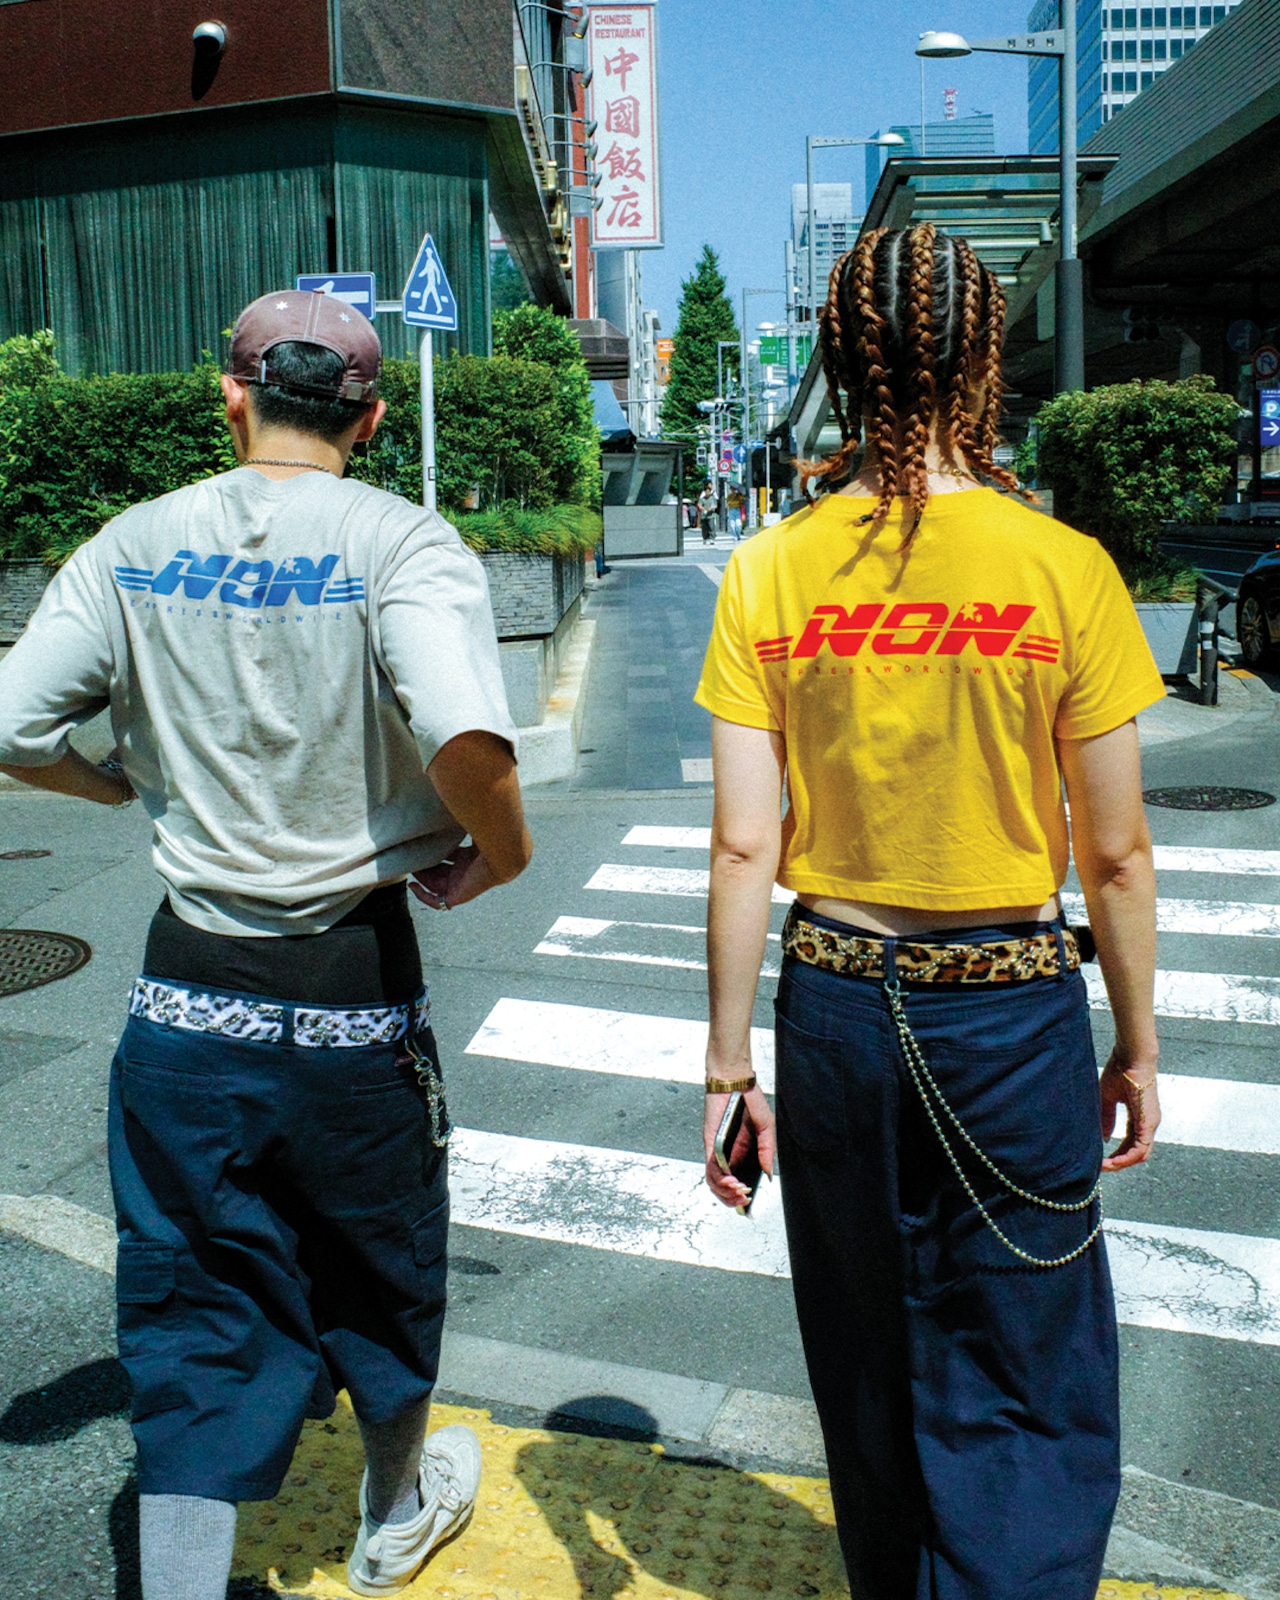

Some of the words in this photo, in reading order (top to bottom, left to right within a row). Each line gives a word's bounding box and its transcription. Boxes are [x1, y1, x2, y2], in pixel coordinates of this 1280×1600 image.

[595, 14, 632, 25] CHINESE
[595, 28, 646, 39] RESTAURANT
[598, 46, 646, 228] 中國飯店
